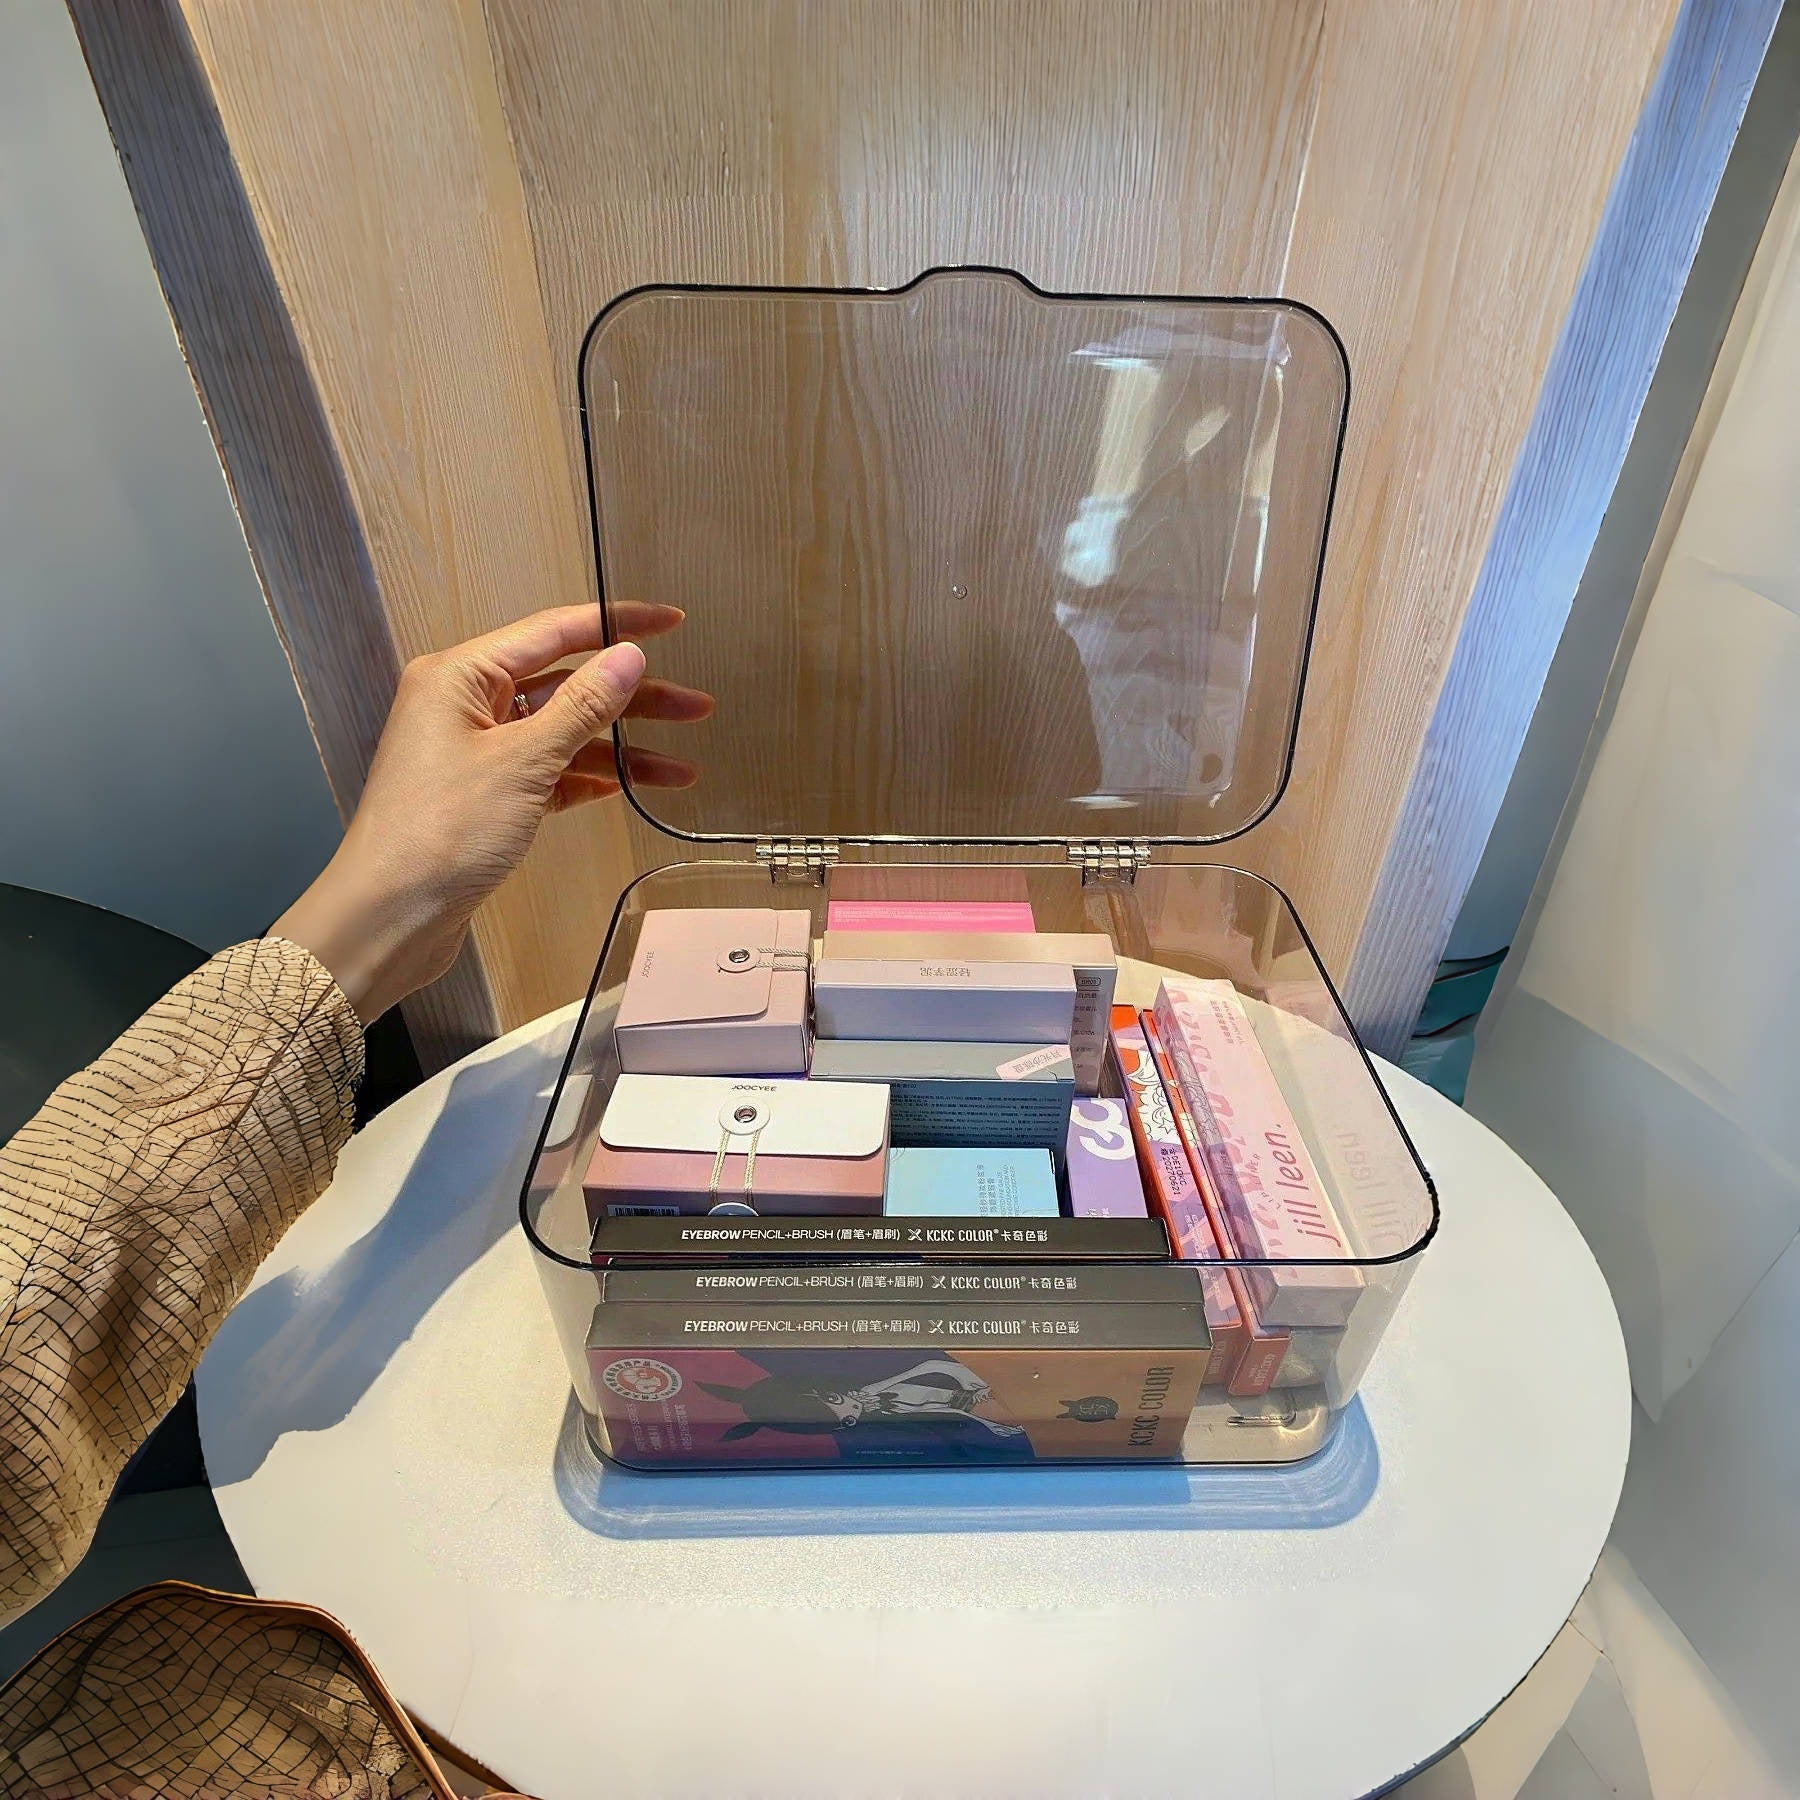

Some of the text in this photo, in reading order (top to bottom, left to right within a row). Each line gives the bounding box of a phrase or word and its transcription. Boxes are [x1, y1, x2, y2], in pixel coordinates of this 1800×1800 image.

[731, 1084, 777, 1092] JOOCYEE
[1283, 1199, 1342, 1248] jill
[681, 1229, 741, 1240] EYEBROW
[742, 1229, 834, 1240] PENCIL+BRUSH
[836, 1228, 901, 1241] (眉笔+眉刷)
[926, 1229, 955, 1242] KCKC
[695, 1276, 758, 1287] EYEBROW
[759, 1276, 854, 1287] PENCIL+BRUSH
[857, 1275, 924, 1289] (眉笔+眉刷)
[951, 1276, 980, 1289] KCKC
[684, 1320, 748, 1332] EYEBROW
[749, 1320, 848, 1332] PENCIL+BRUSH
[851, 1319, 920, 1333] (眉笔+眉刷)
[949, 1320, 979, 1334] KCKC
[1127, 1366, 1176, 1446] KCKC COLOR
